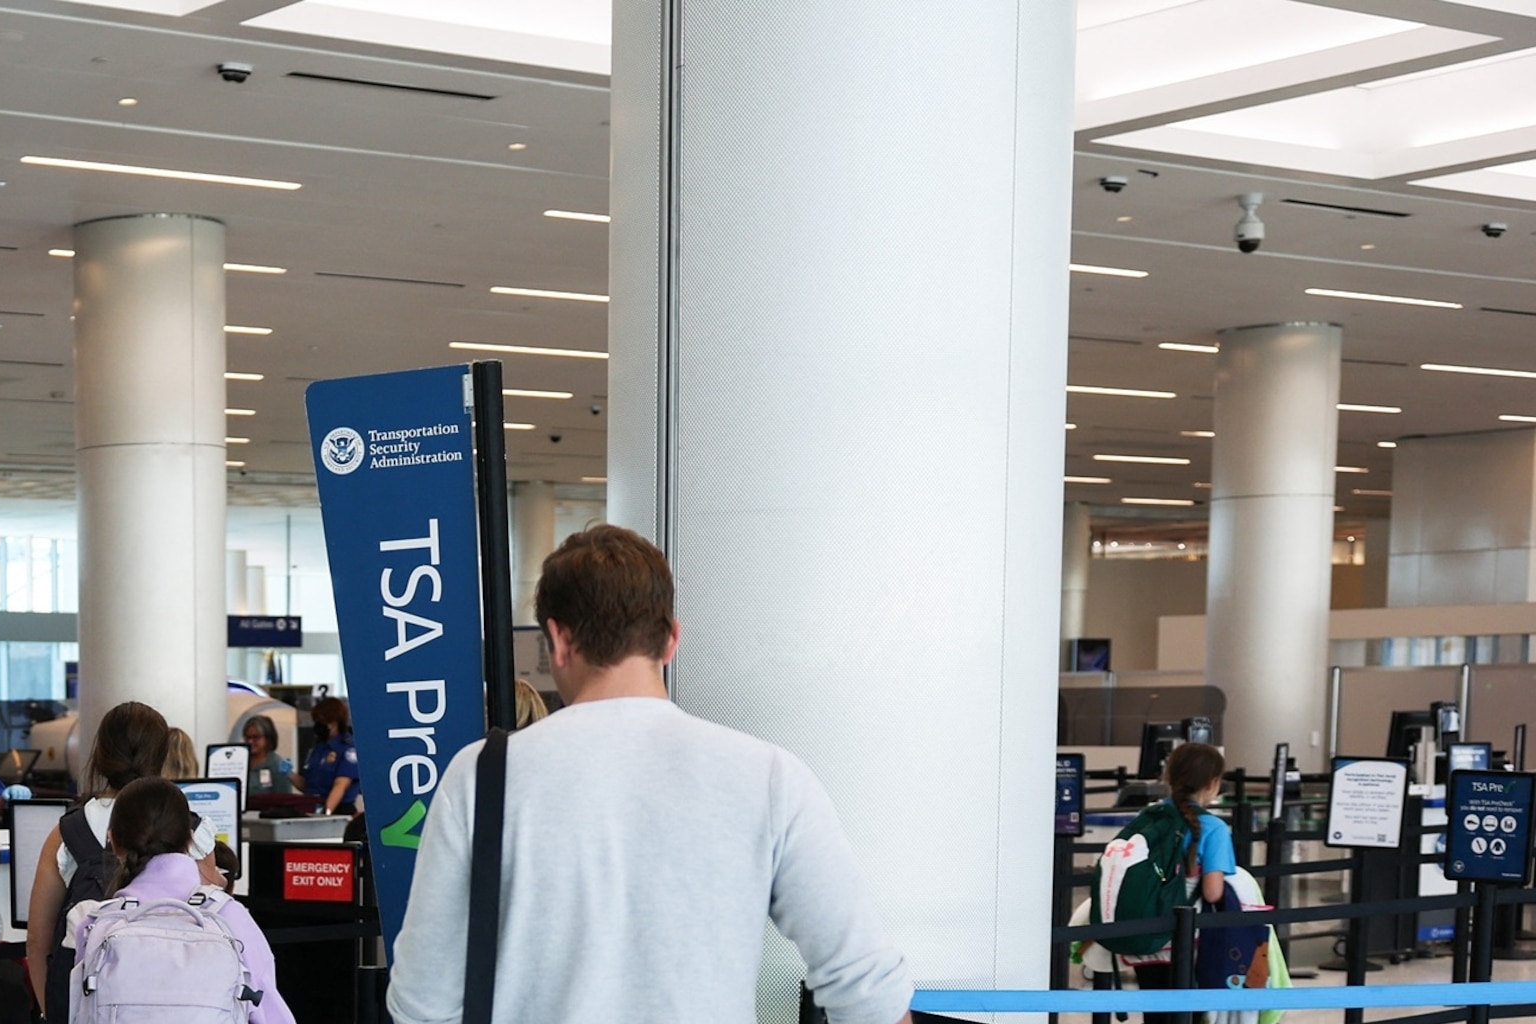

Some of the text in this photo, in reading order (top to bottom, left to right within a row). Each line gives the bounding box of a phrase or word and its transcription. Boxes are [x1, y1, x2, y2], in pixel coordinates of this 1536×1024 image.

[368, 424, 459, 442] Transportation
[369, 441, 420, 455] Security
[370, 450, 462, 469] Administration
[379, 518, 447, 795] TSA Pre
[1471, 781, 1488, 792] TSA
[286, 862, 350, 874] EMERGENCY
[292, 875, 343, 887] EXIT ONLY
